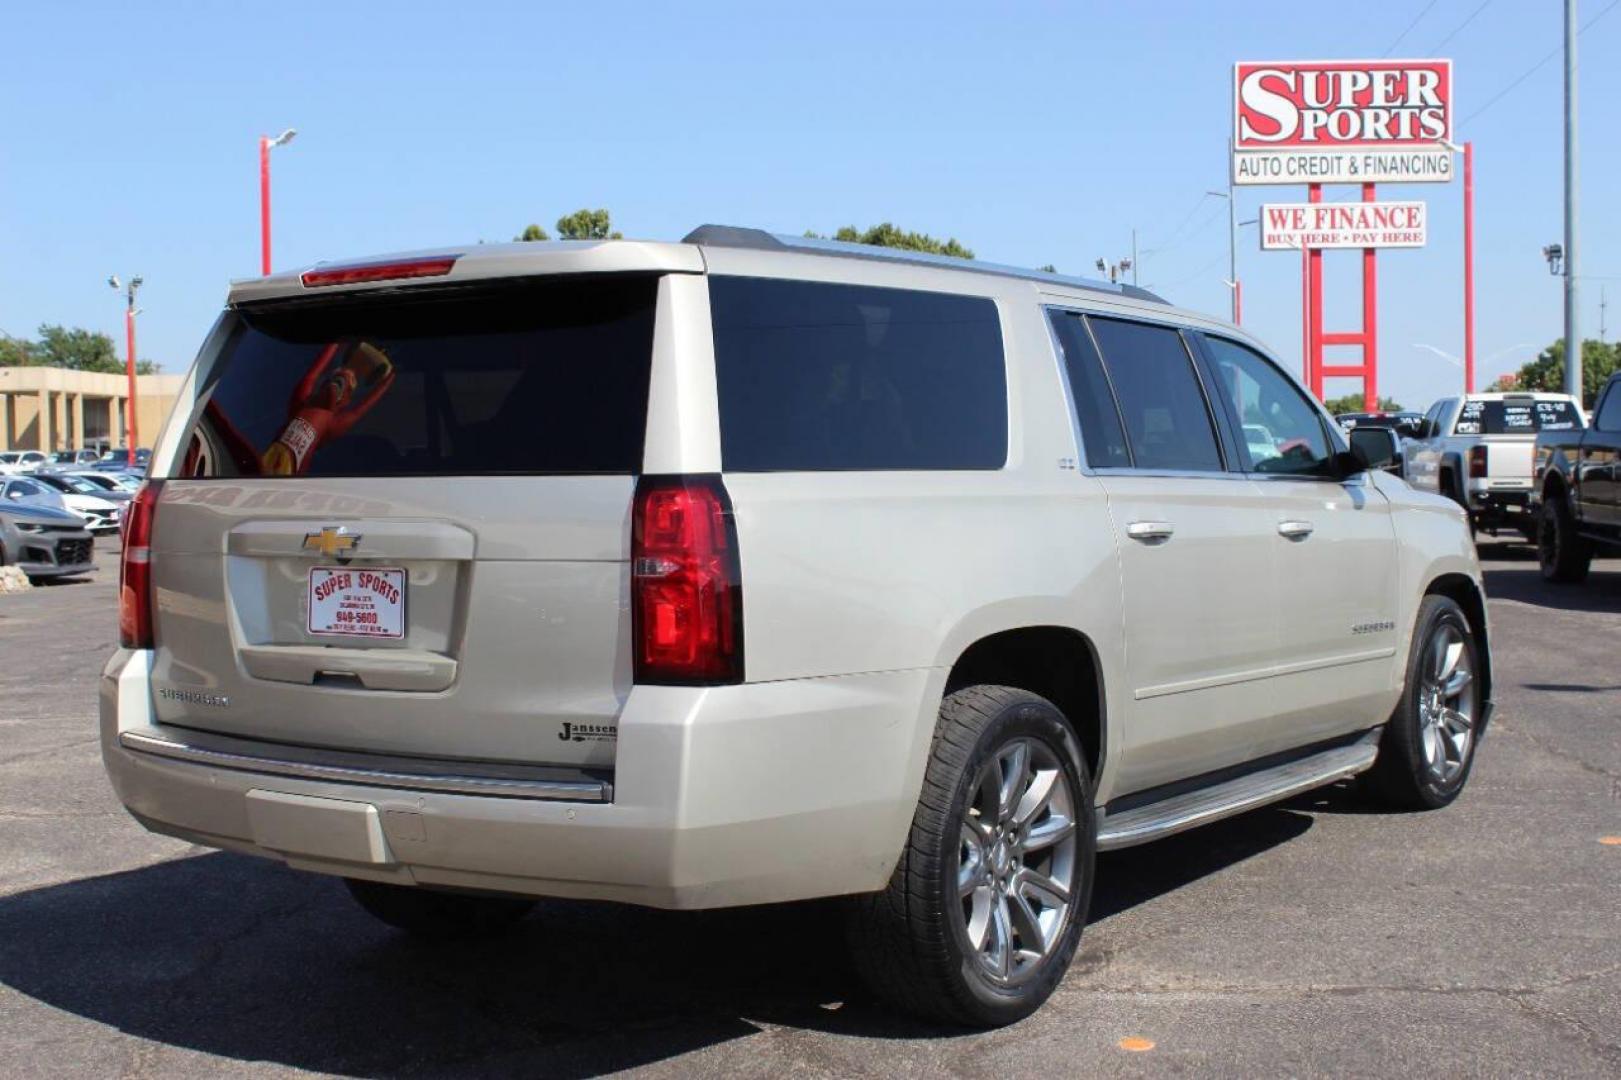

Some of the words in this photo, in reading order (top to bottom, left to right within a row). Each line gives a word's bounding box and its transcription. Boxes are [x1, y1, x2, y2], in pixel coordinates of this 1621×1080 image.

[1241, 68, 1443, 142] SUPER
[1239, 156, 1281, 176] AUTO
[1286, 156, 1343, 175] CREDIT
[1349, 157, 1359, 175] &
[1364, 155, 1449, 175] FINANCING
[1267, 208, 1307, 230] WE
[1314, 207, 1422, 230] FINANCE
[1267, 233, 1296, 244] BUY
[1301, 232, 1340, 244] HERE
[1352, 232, 1378, 243] PAY
[1382, 231, 1423, 243] HERE
[314, 573, 352, 601] SUPER
[358, 572, 400, 605] SPORTS
[558, 722, 618, 741] Janssen
